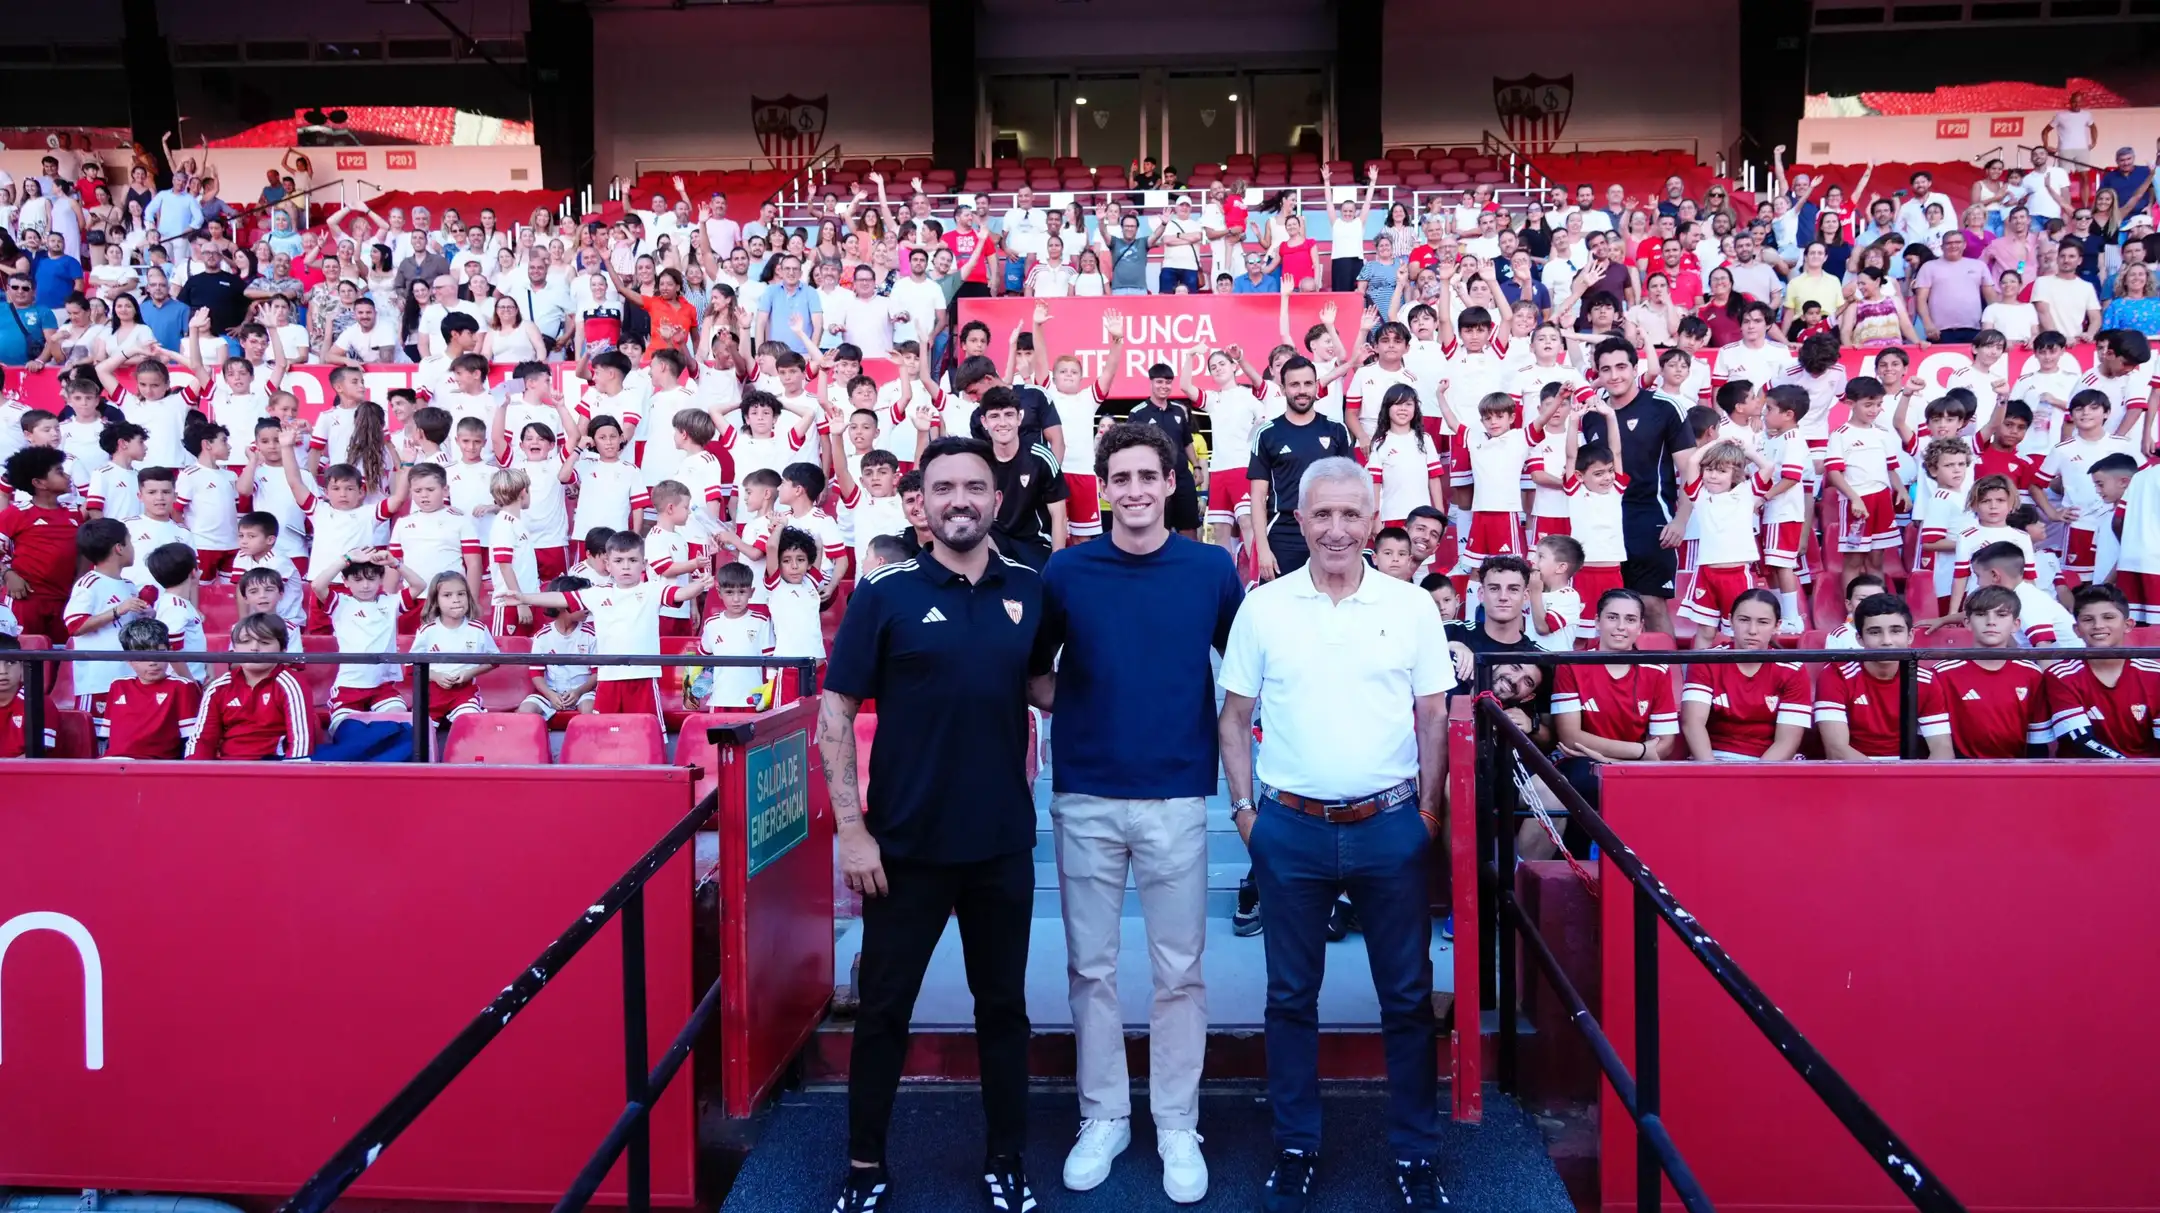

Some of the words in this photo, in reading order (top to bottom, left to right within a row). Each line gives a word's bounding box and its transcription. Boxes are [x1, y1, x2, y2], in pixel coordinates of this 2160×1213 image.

[1947, 123, 1967, 134] P20
[1994, 122, 2013, 133] P21
[346, 156, 365, 166] P22
[389, 155, 407, 166] P20
[1126, 349, 1244, 378] RIND
[757, 760, 786, 803] SALIDA
[787, 754, 798, 786] DE
[751, 790, 804, 849] EMERGENCIA
